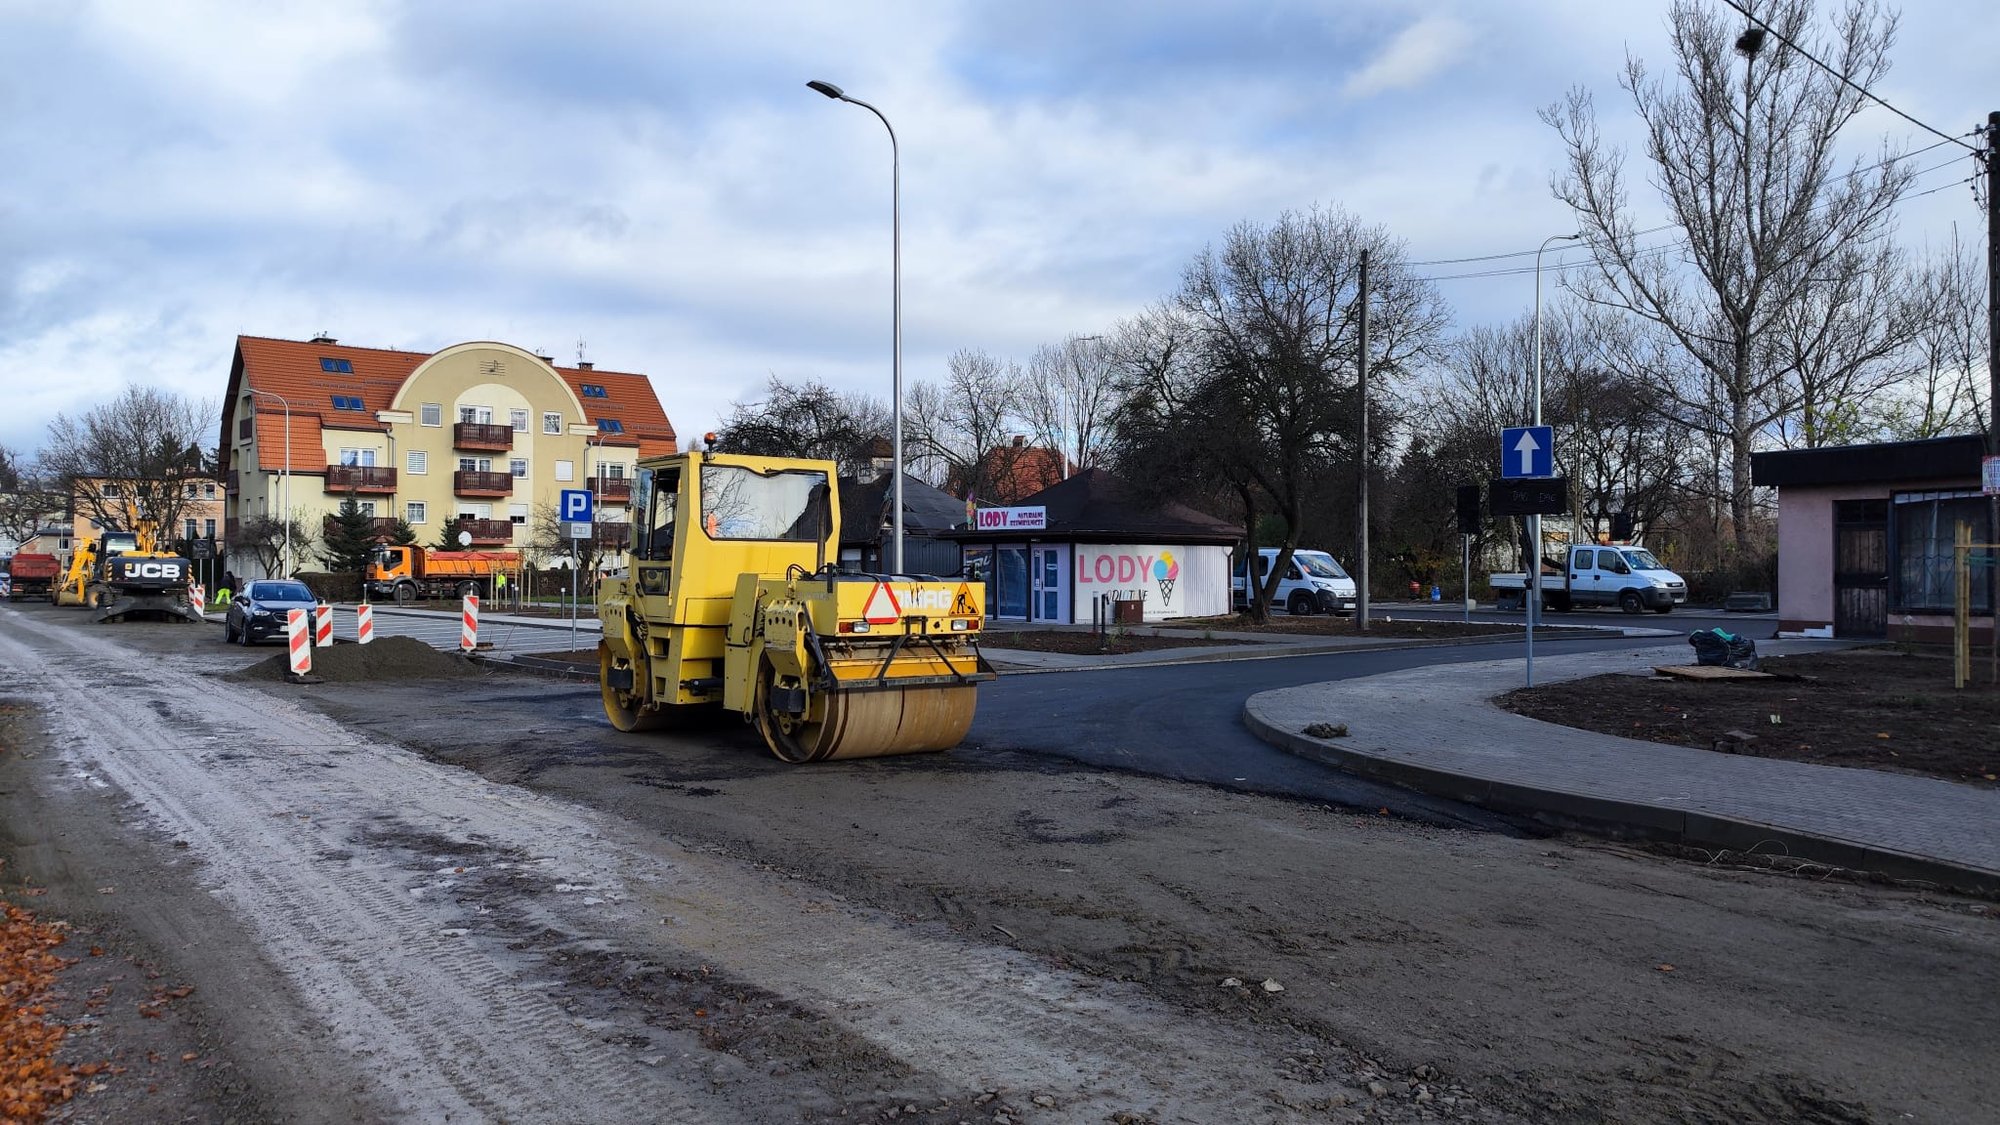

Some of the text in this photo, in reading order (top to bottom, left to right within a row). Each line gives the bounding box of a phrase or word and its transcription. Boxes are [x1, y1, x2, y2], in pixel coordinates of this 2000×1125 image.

[568, 493, 587, 518] P
[979, 511, 1009, 527] LODY
[124, 563, 180, 578] JCB
[1079, 554, 1154, 583] LODY
